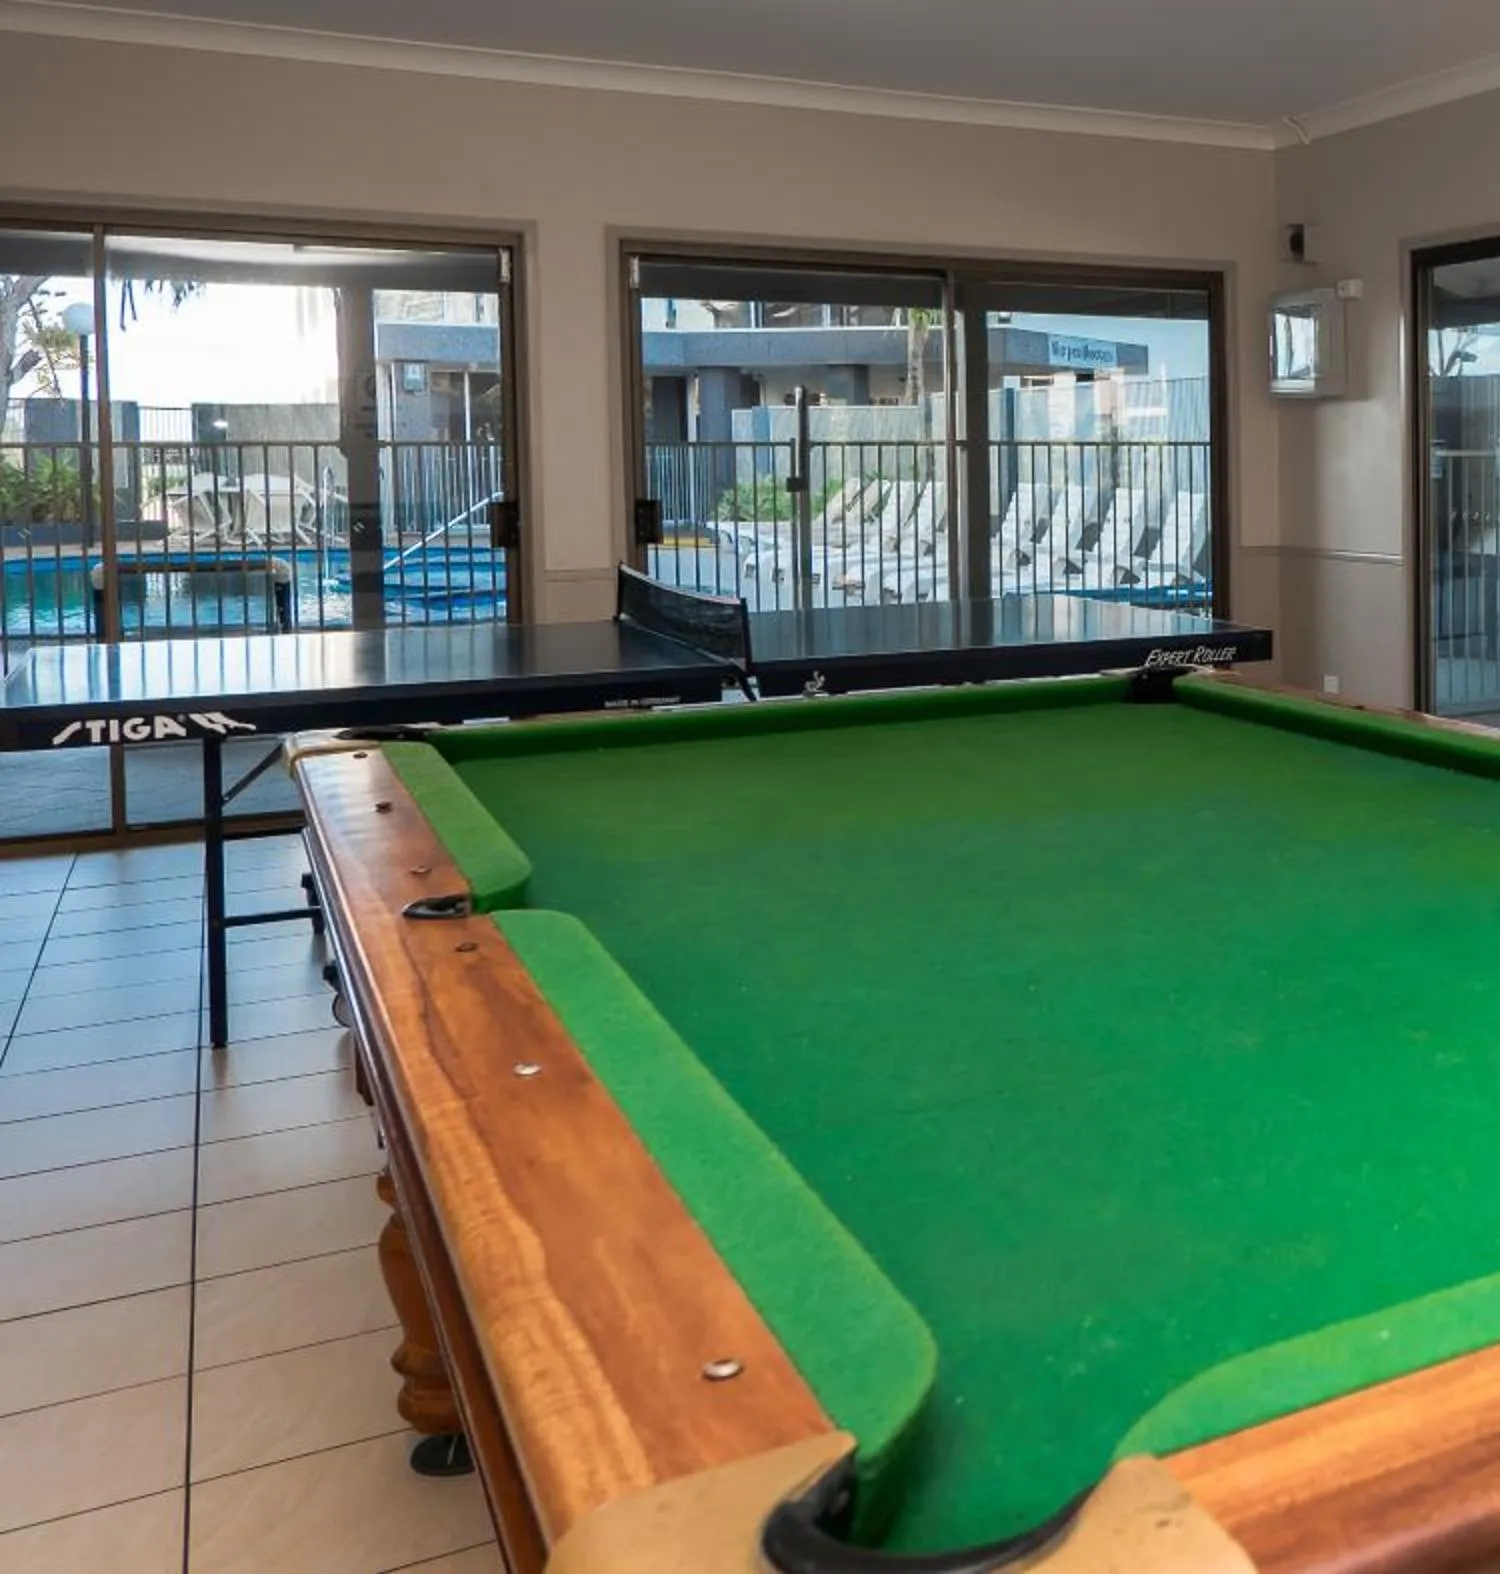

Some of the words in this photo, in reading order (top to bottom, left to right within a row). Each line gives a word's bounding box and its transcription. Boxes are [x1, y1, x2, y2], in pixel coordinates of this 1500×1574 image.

[1144, 648, 1193, 667] EXPERT
[1193, 645, 1237, 664] ROLLER
[52, 714, 187, 746] STIGA
